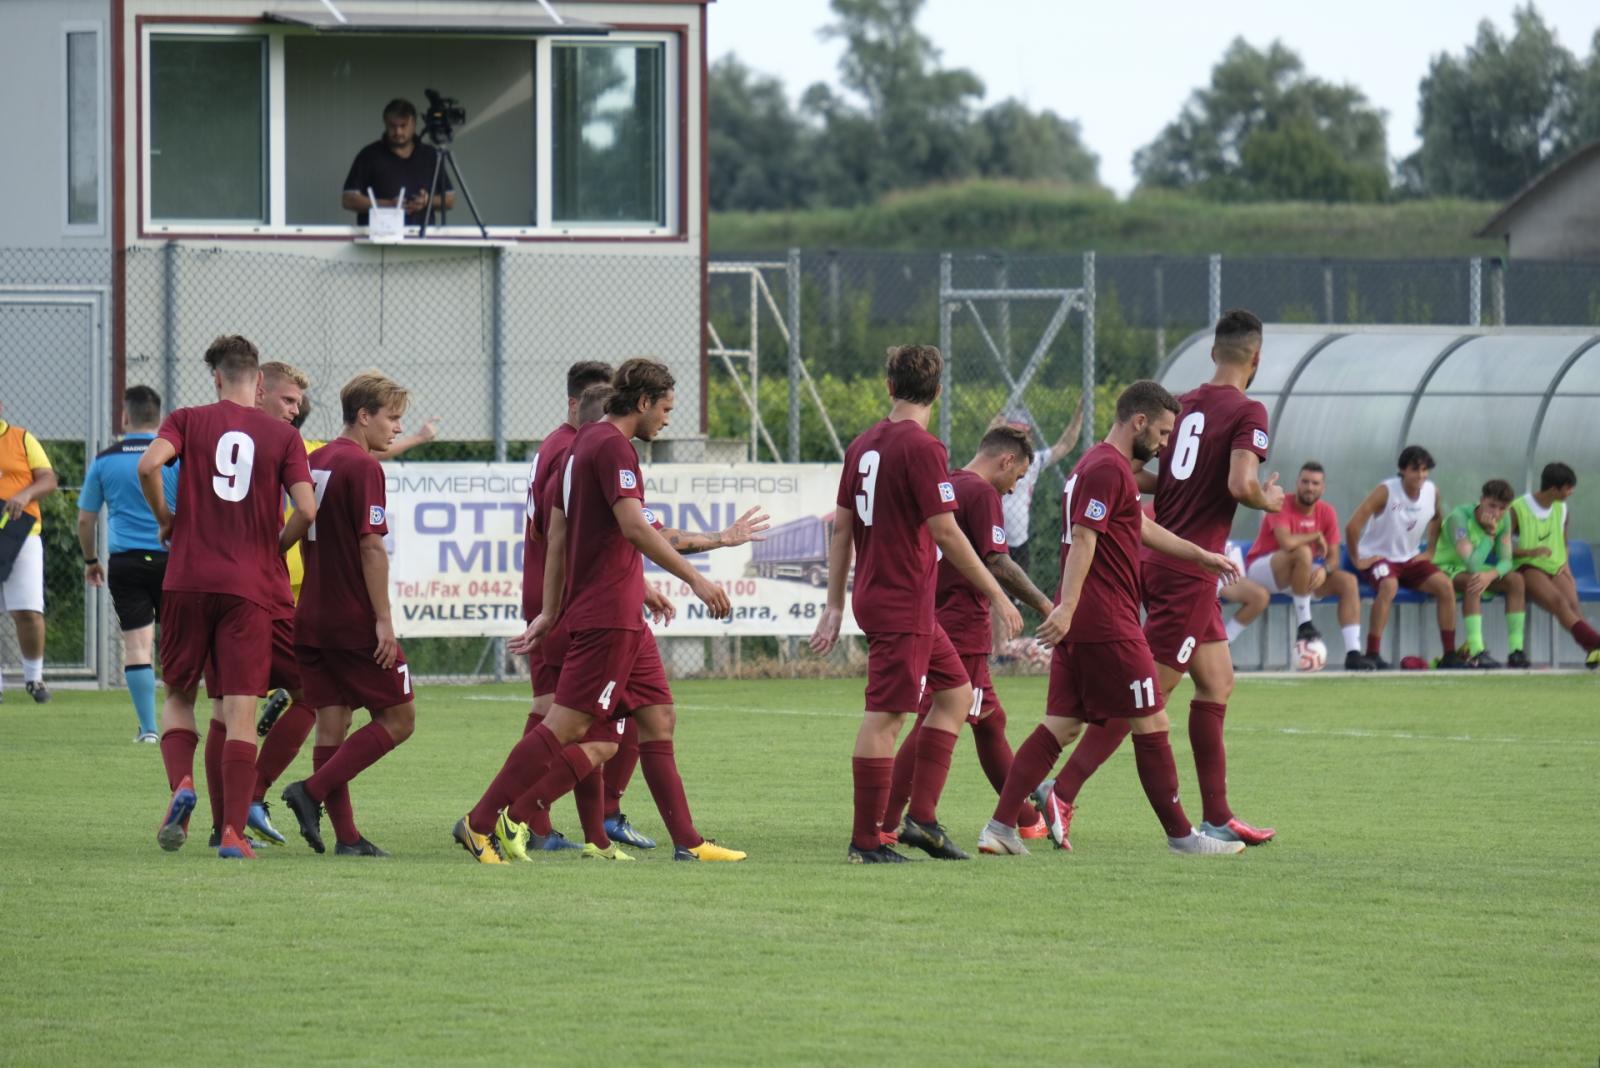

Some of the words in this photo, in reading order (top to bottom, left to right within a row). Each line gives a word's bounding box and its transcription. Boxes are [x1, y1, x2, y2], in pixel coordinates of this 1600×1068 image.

[1170, 410, 1205, 481] 6
[212, 430, 255, 502] 9
[385, 476, 529, 493] OMMERCIO
[691, 477, 798, 494] FERROSI
[854, 450, 880, 527] 3
[395, 581, 461, 599] Tel./Fax
[468, 580, 524, 597] 0442.
[403, 603, 525, 621] VALLESTR
[1176, 636, 1196, 664] 6
[397, 664, 412, 696] 7
[598, 680, 616, 710] 4
[1129, 676, 1155, 709] 11
